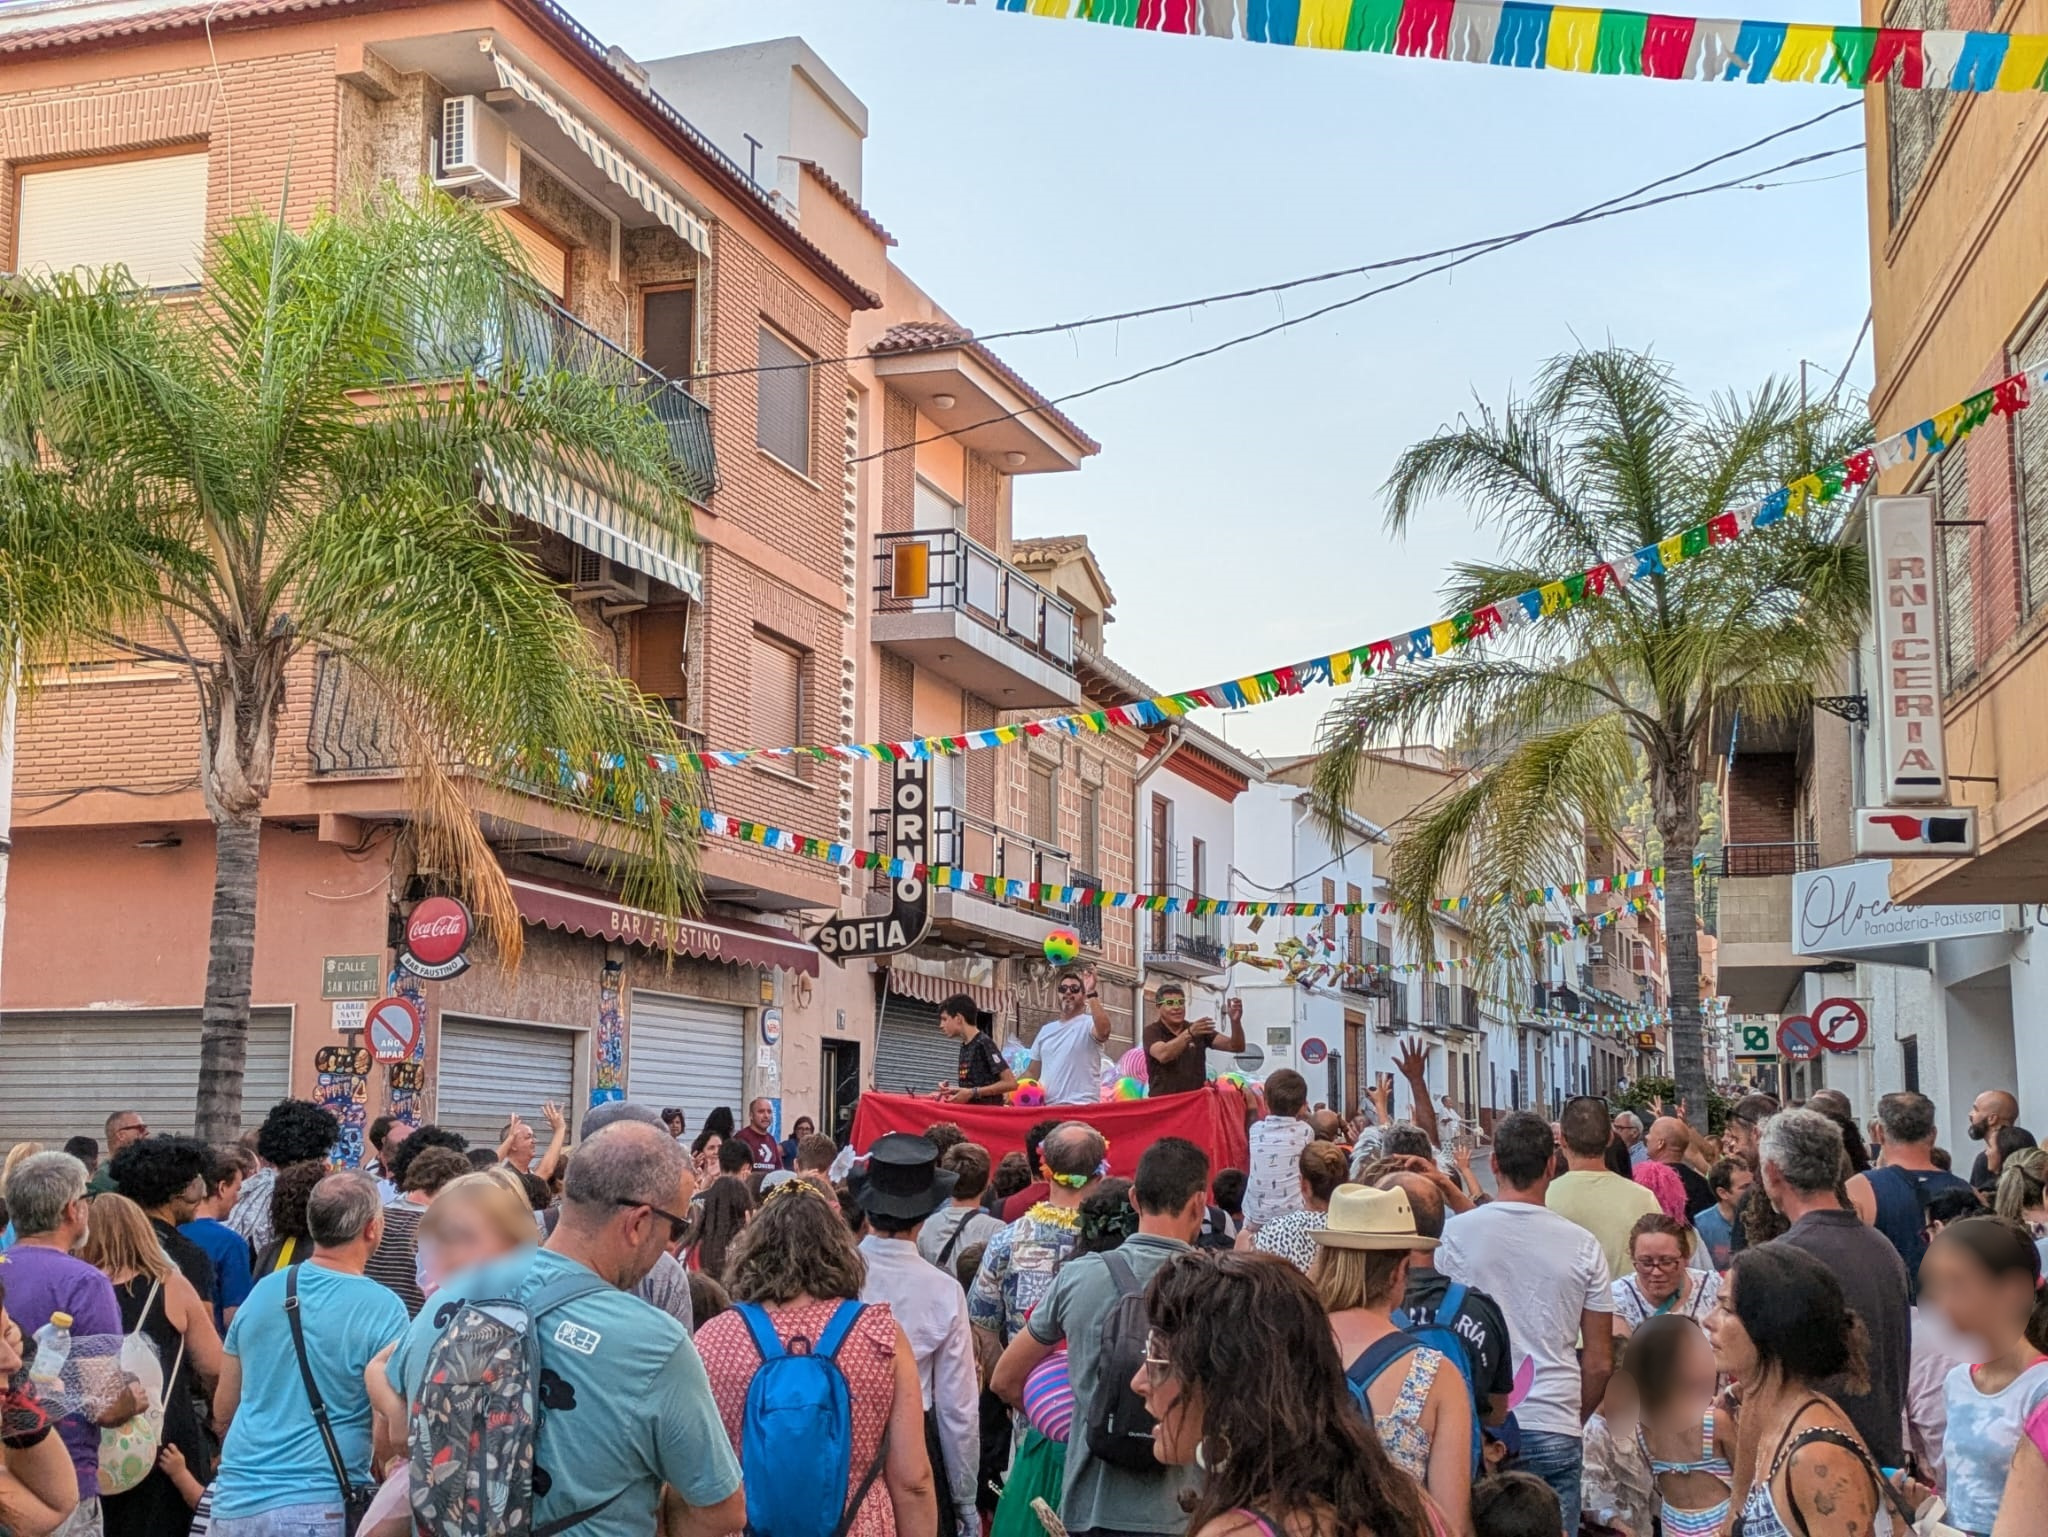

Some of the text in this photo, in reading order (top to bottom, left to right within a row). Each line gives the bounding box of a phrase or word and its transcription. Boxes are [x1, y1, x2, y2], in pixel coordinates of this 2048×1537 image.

[1887, 531, 1936, 772] ARNICERIA
[896, 758, 924, 903] HORNO
[611, 911, 641, 935] BAR
[819, 919, 907, 953] SOFIA
[337, 961, 367, 972] CALLE
[405, 957, 458, 977] BAR FAUSTINO
[327, 979, 377, 993] SAN VICENTE
[335, 1002, 365, 1010] CARRER
[381, 1038, 401, 1047] AÑO
[375, 1051, 405, 1059] IMPAR
